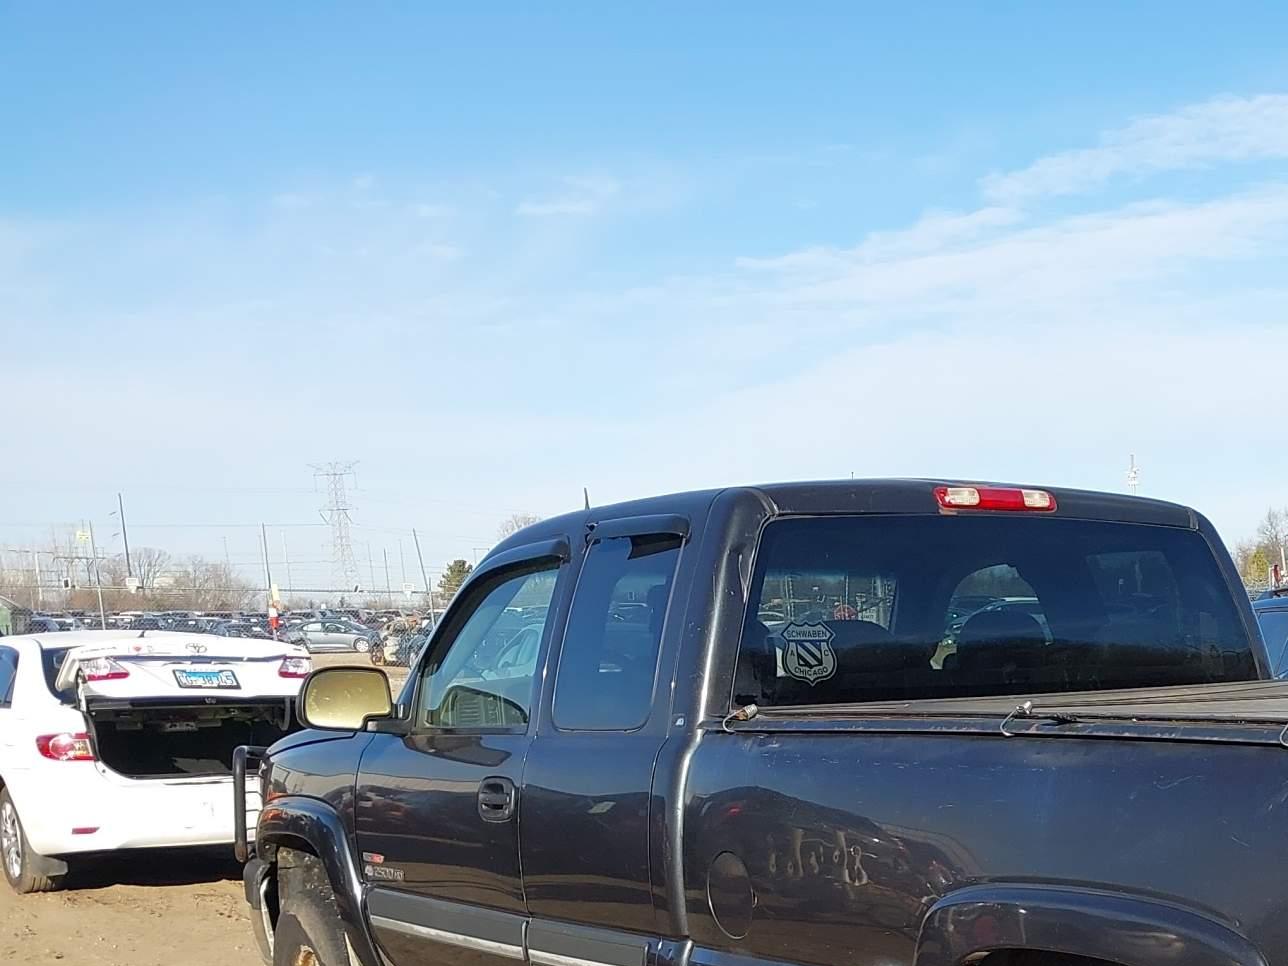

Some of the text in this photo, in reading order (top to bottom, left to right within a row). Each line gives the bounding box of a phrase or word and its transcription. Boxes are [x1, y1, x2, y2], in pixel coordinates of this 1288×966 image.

[786, 630, 827, 638] SCHWABEN
[790, 649, 829, 657] A C
[794, 666, 828, 676] CHICAGO
